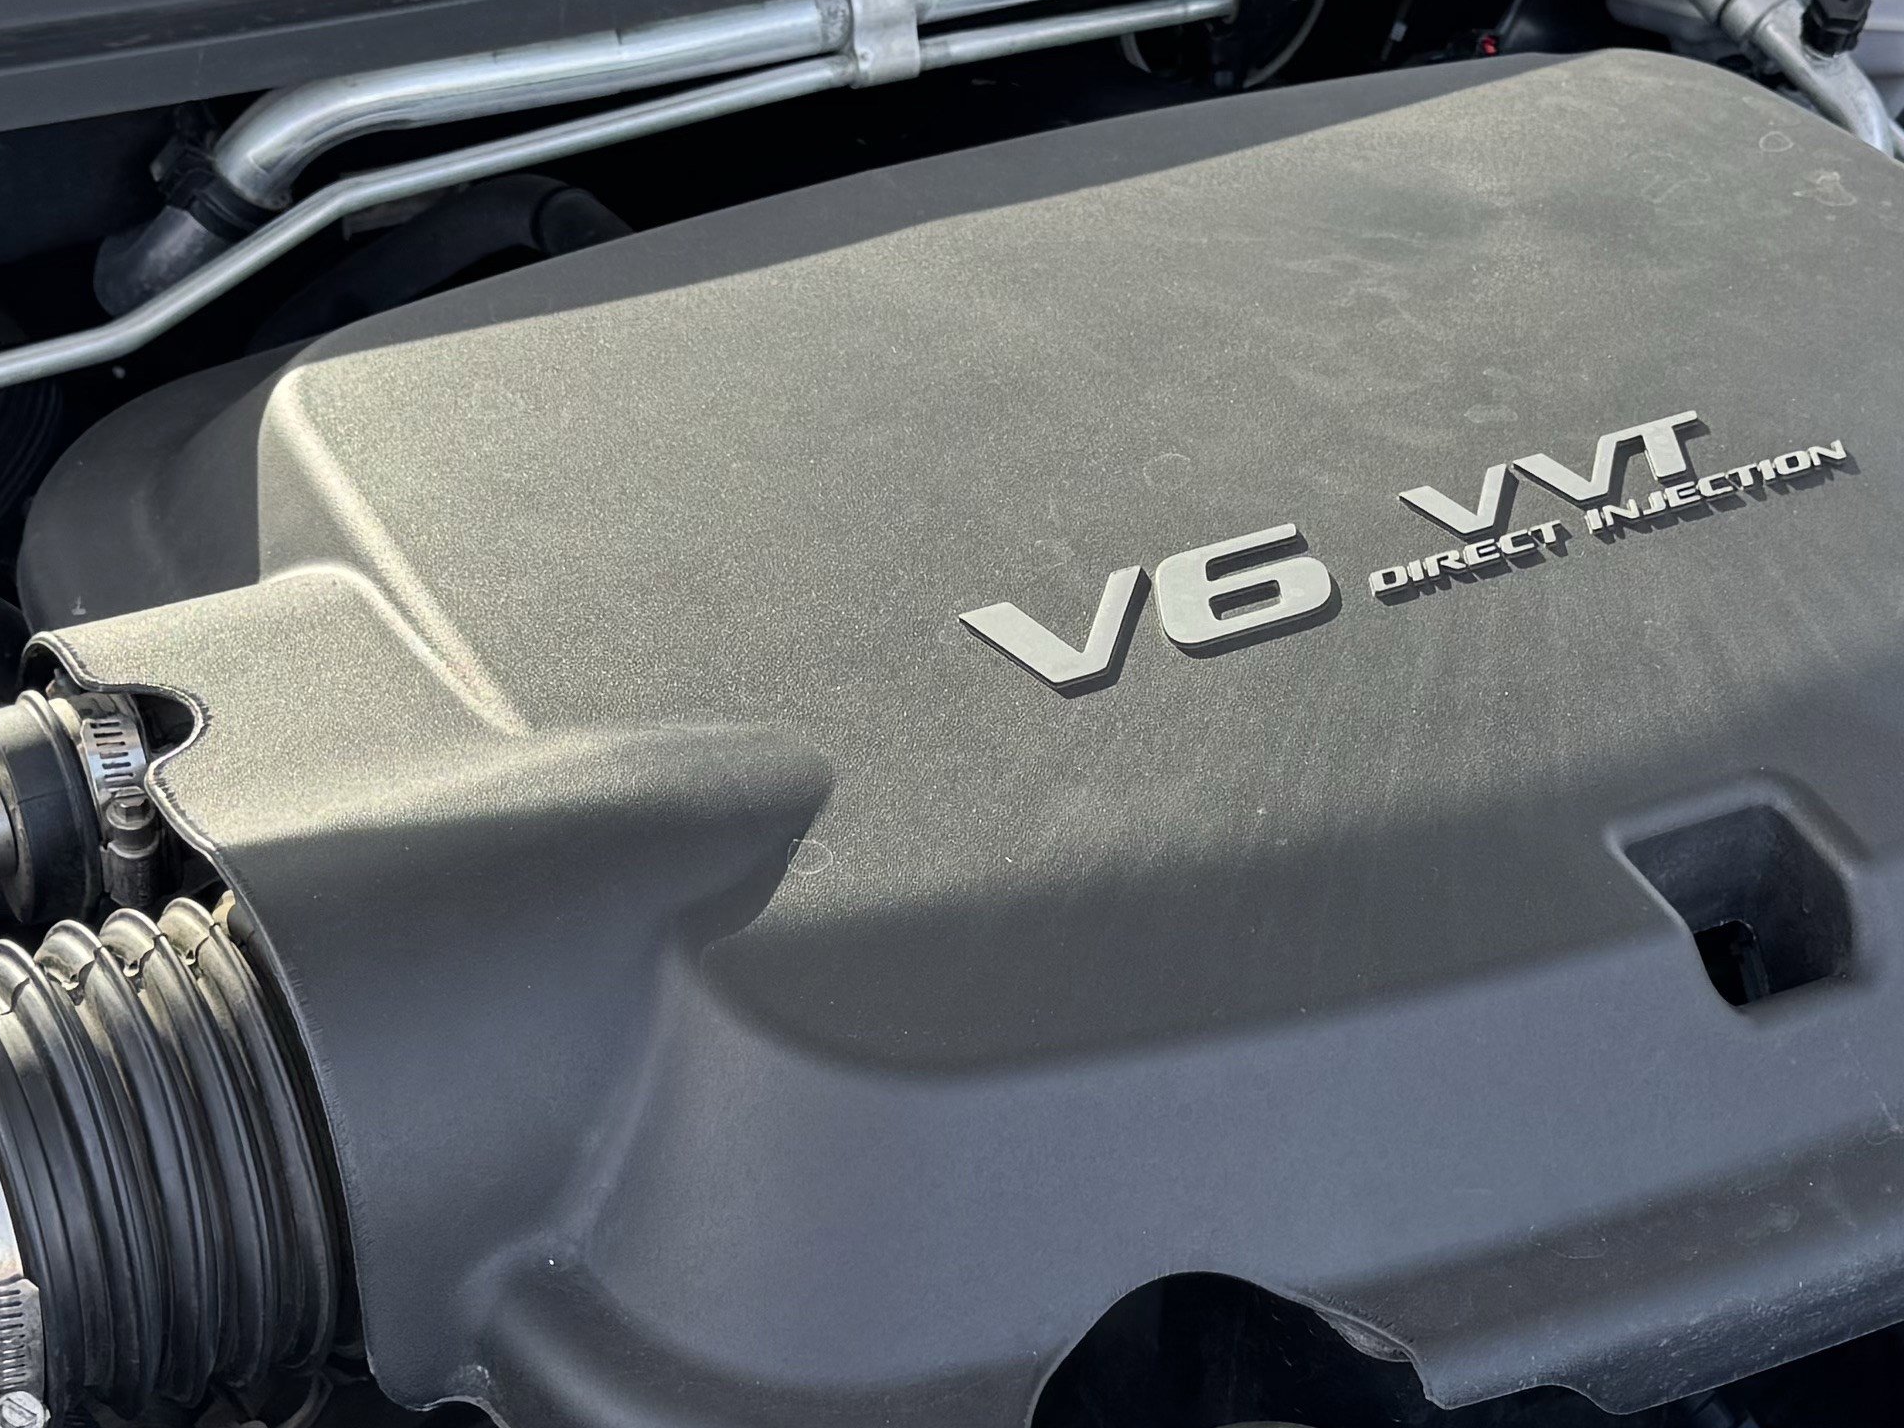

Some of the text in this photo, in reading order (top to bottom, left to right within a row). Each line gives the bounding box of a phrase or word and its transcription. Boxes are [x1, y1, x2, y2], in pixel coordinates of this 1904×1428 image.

[1369, 440, 1849, 600] DIRECT INJECTION
[1398, 410, 1700, 535] VVT
[958, 523, 1336, 687] V6
